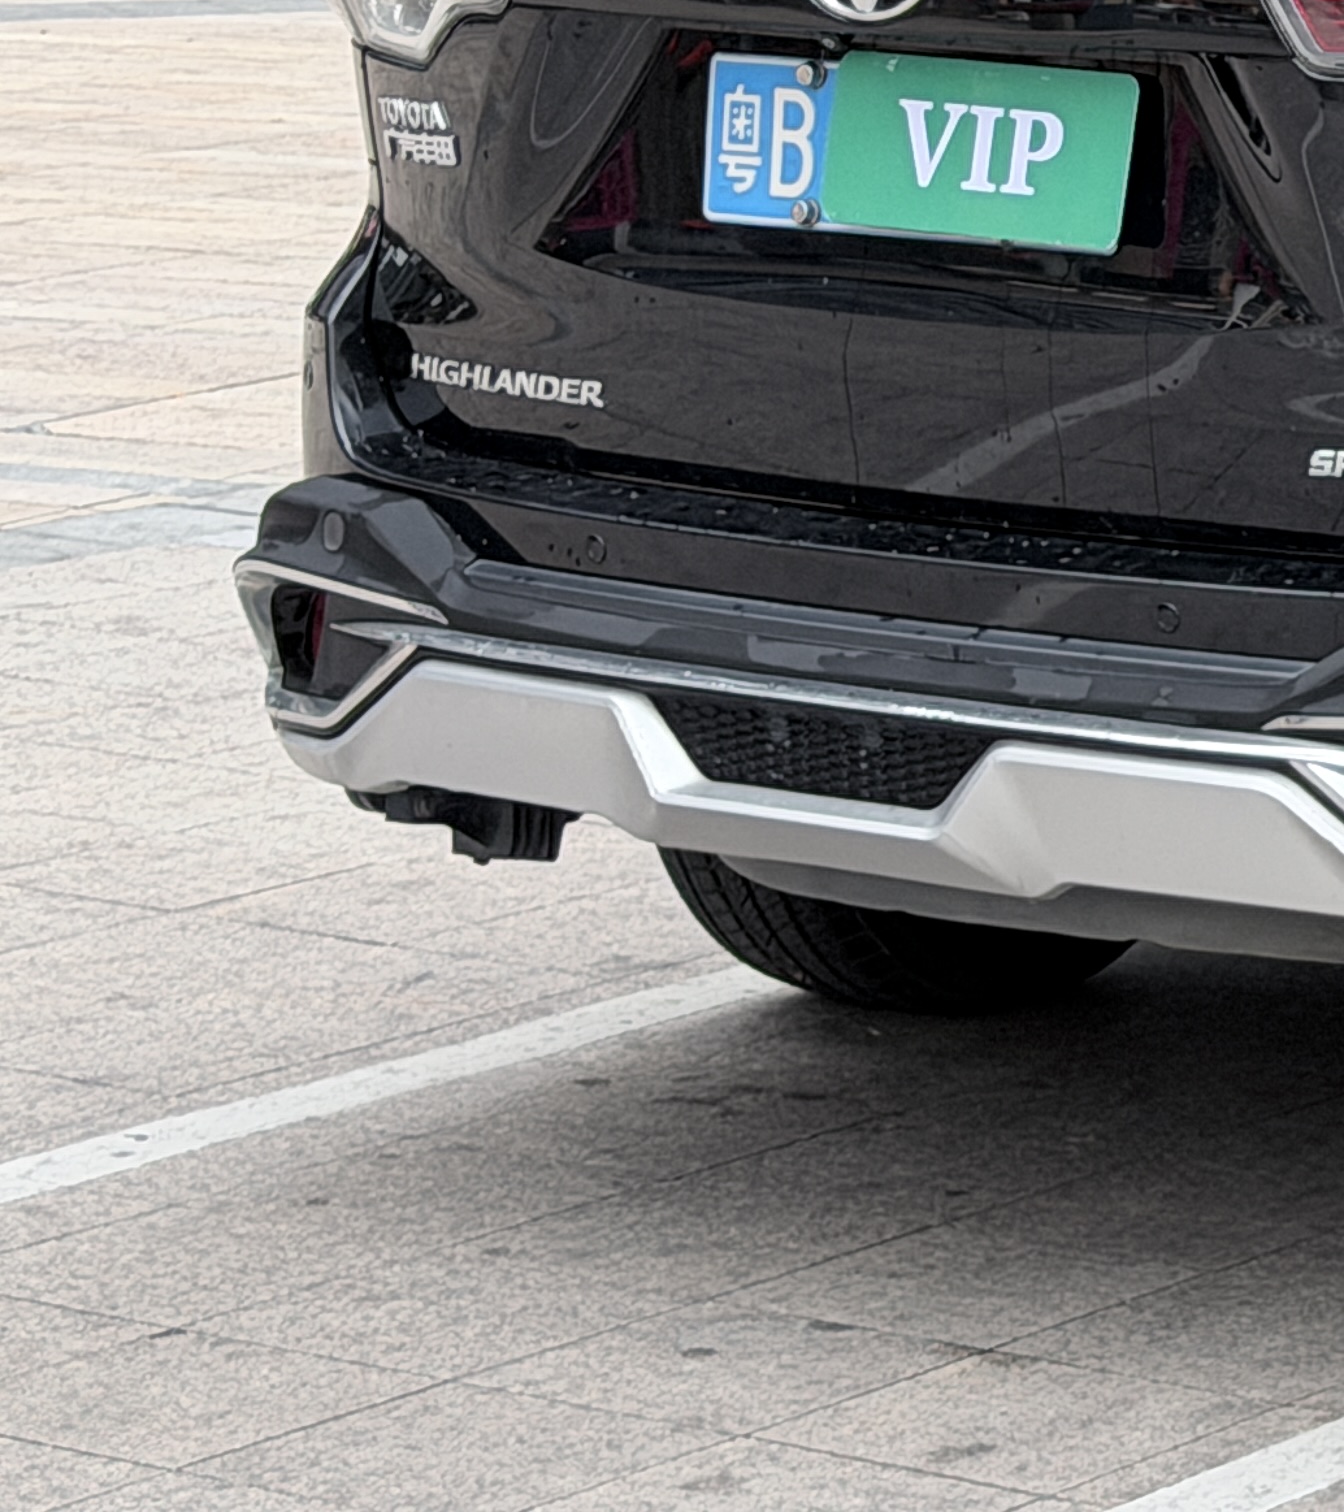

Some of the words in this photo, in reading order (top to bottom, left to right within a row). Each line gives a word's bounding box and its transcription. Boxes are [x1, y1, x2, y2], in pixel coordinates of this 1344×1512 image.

[377, 97, 447, 130] TOYOTA
[898, 97, 1065, 196] VIP
[411, 352, 604, 408] HIGHLANDER
